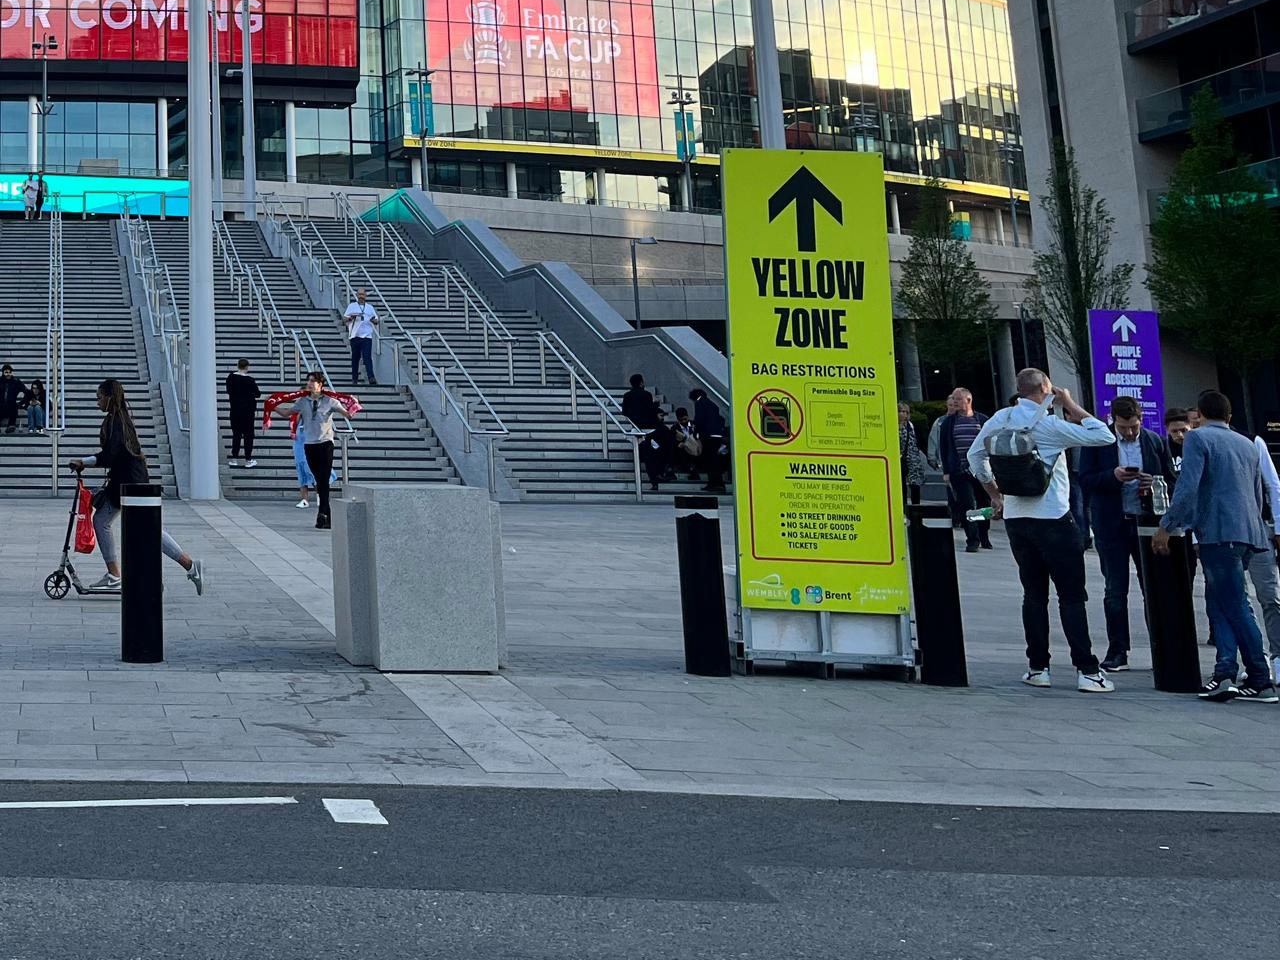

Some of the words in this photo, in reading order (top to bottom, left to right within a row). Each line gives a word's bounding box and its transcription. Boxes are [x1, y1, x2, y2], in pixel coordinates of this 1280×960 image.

[522, 7, 620, 37] Emirates
[524, 35, 560, 61] FA
[564, 37, 622, 64] CUP
[751, 257, 864, 300] YELLOW
[774, 307, 848, 349] ZONE
[1111, 346, 1141, 357] PURPLE
[1117, 359, 1137, 370] ZONE
[751, 363, 778, 376] BAG
[782, 364, 876, 379] RESTRICTIONS
[1105, 373, 1152, 386] ACCESSIBLE
[812, 387, 848, 396] Permissible
[849, 388, 861, 397] Bag
[1117, 387, 1142, 398] ROUTE
[789, 463, 847, 476] WARNING
[824, 494, 865, 502] PROTECTION
[798, 512, 825, 520] STREET
[826, 513, 861, 522] DRINKING
[799, 522, 817, 530] SALE
[829, 523, 855, 531] GOODS
[800, 531, 847, 540] SALE/RESALE
[848, 533, 858, 541] OF
[788, 541, 818, 550] TICKETS
[747, 589, 789, 599] WEMBLEY
[825, 591, 852, 601] Brent
